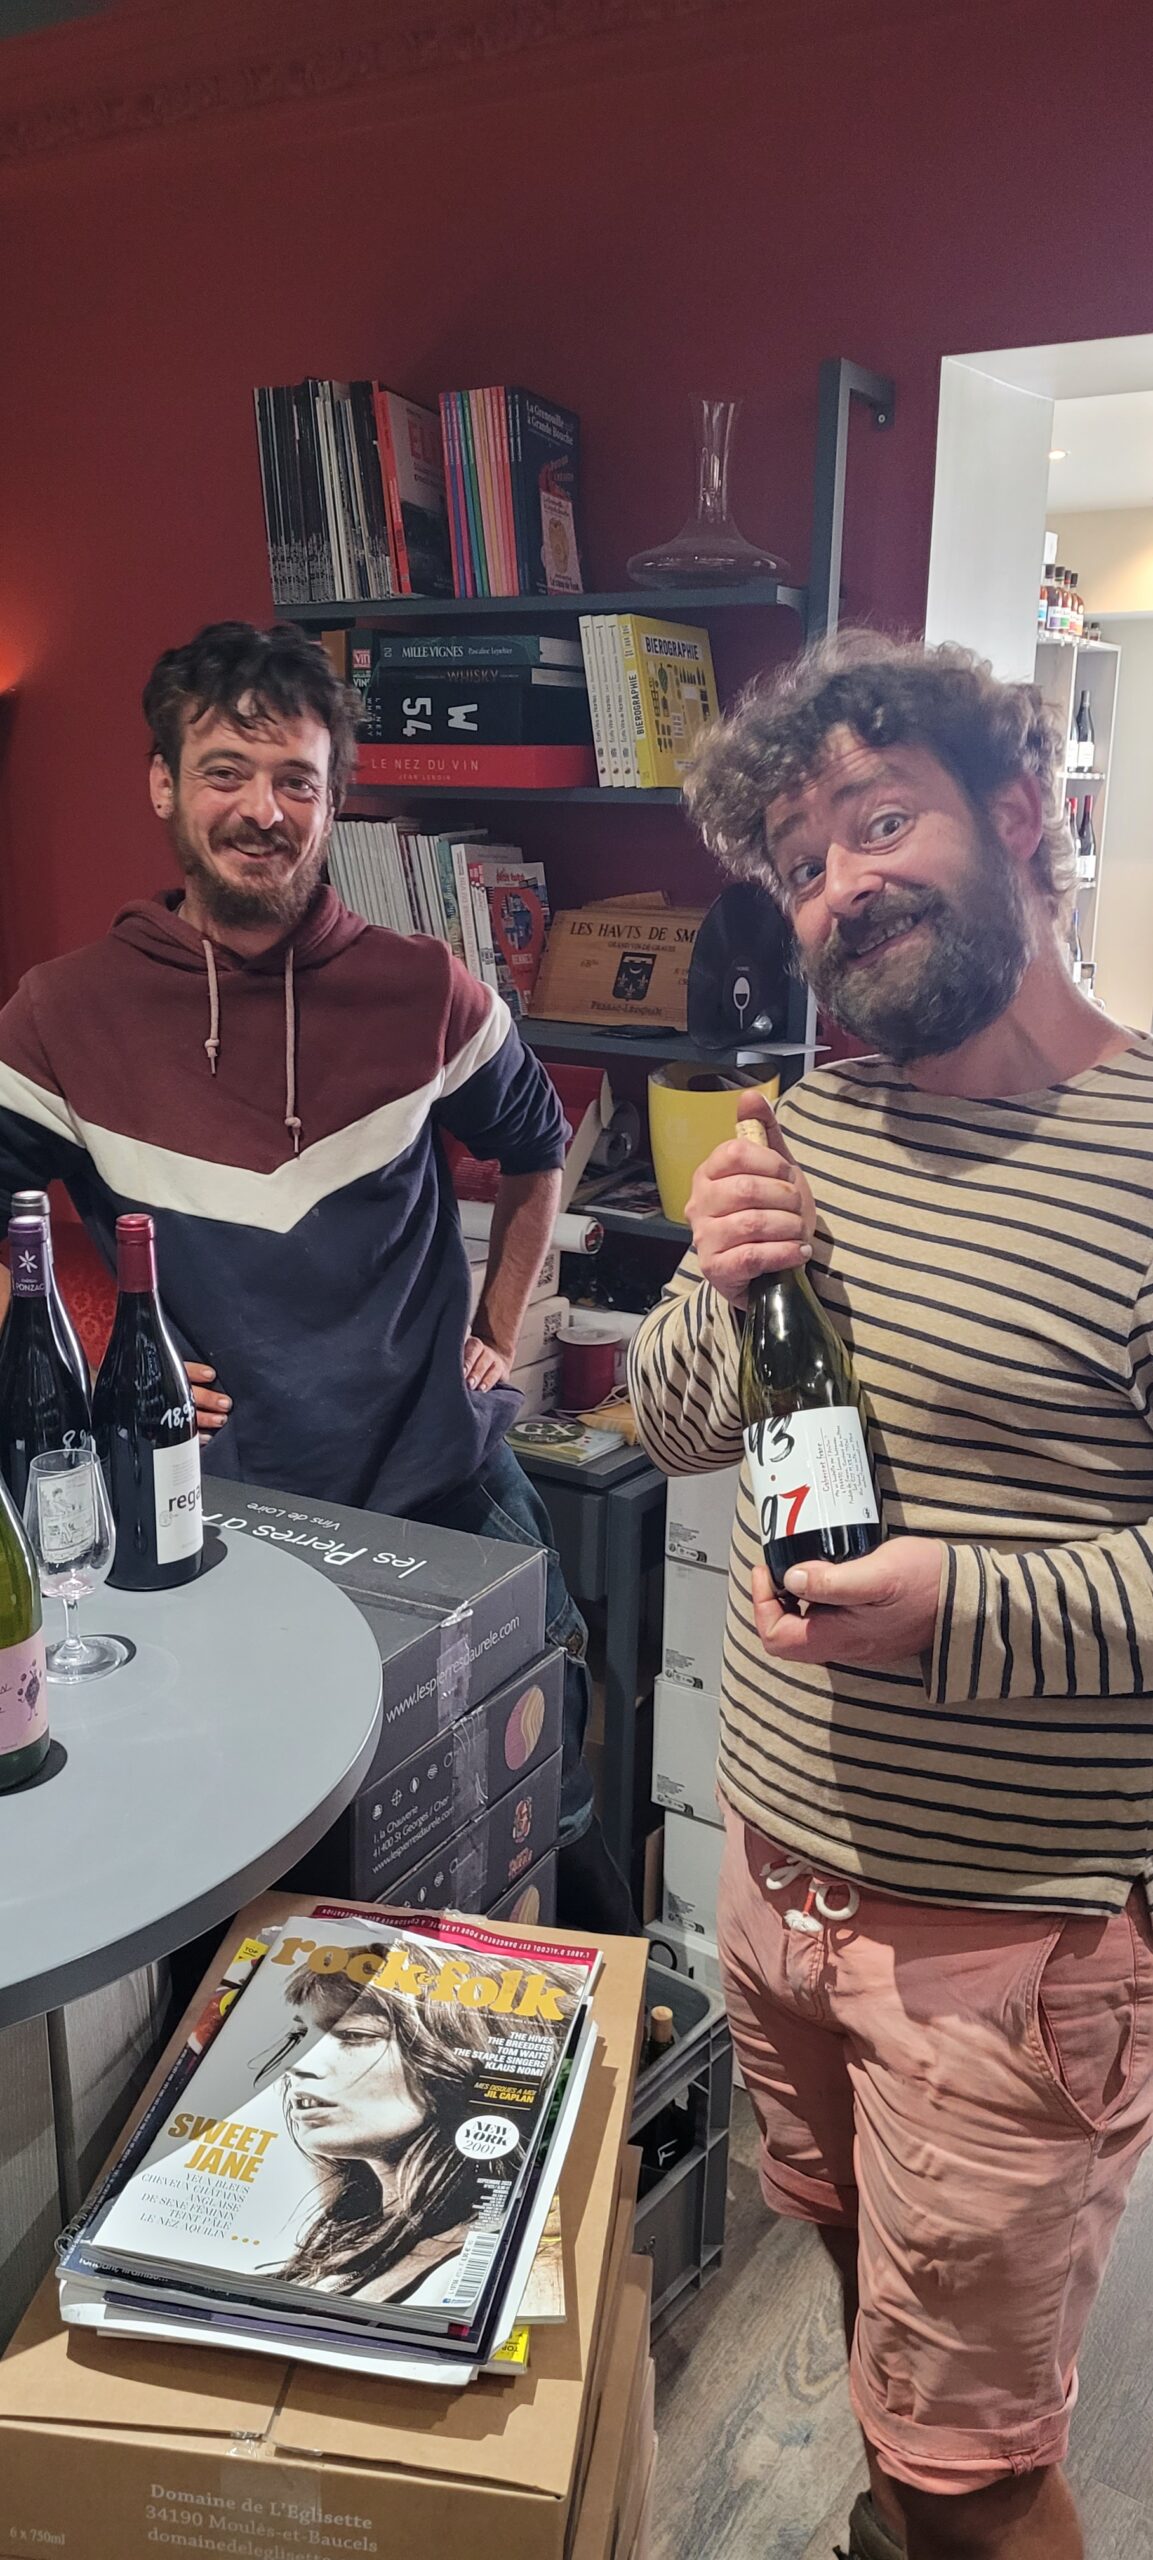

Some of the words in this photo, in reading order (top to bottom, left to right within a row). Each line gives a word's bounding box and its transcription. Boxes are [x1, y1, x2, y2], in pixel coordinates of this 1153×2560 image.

[402, 646, 431, 658] MILLE
[431, 645, 464, 658] VIGNES
[645, 636, 699, 660] BIEROGRAPHIE
[447, 669, 499, 682] WHISKY
[629, 673, 645, 735] BIEROGRAPHIE
[402, 697, 432, 737] 54
[371, 759, 387, 769] LE
[394, 759, 420, 769] NEZ
[428, 759, 445, 770] DU
[452, 760, 479, 771] VIN
[570, 921, 593, 937] LES
[599, 922, 642, 940] HAVTS
[648, 926, 668, 940] DE
[513, 1422, 578, 1437] GX
[246, 1502, 285, 1518] Loire
[287, 1511, 309, 1522] de
[310, 1517, 341, 1531] Vins
[252, 1524, 368, 1566] Pierres
[371, 1551, 428, 1579] les
[385, 1615, 521, 1725] www.lespierresdaurele.com
[451, 1924, 460, 1933] LA
[461, 1926, 479, 1939] POUR
[480, 1933, 518, 1949] DANGEREUX
[519, 1941, 532, 1951] EST
[533, 1944, 564, 1957] D'ALCOOL
[565, 1949, 590, 1959] L'ABUS
[488, 2036, 505, 2046] THE
[505, 2037, 552, 2053] BREEDERS
[510, 2031, 528, 2041] THE
[527, 2034, 554, 2045] HIVES
[453, 2047, 472, 2057] THE
[471, 2050, 506, 2063] STAPLE
[506, 2056, 546, 2068] SINGERS
[497, 2046, 518, 2056] TOM
[519, 2048, 549, 2060] WAITS
[484, 2061, 516, 2073] KLAUS
[516, 2066, 544, 2077] NOMI
[484, 2090, 498, 2098] JIL
[499, 2092, 535, 2103] CAPLAN
[167, 2113, 279, 2155] SWEET
[476, 2120, 508, 2136] NEW
[465, 2128, 507, 2146] YORK
[462, 2140, 496, 2155] 2001
[184, 2145, 264, 2183] JANE
[141, 2174, 190, 2191] CHEVEUX
[186, 2173, 212, 2186] YEUX
[214, 2179, 251, 2194] BLEUS
[141, 2193, 160, 2202] DE
[160, 2197, 189, 2209] SEXE
[189, 2193, 241, 2212] ANGLAISE
[169, 2208, 201, 2224] TEINT
[140, 2212, 156, 2222] LE
[159, 2217, 180, 2229] NEZ
[184, 2223, 227, 2239] AQUILIN
[150, 2483, 237, 2512] Domaine
[240, 2497, 264, 2514] de
[269, 2500, 374, 2530] L'Eglisette
[145, 2504, 204, 2527] 34190
[9, 2526, 18, 2539] 6
[19, 2529, 28, 2541] x
[30, 2528, 66, 2546] 750ml
